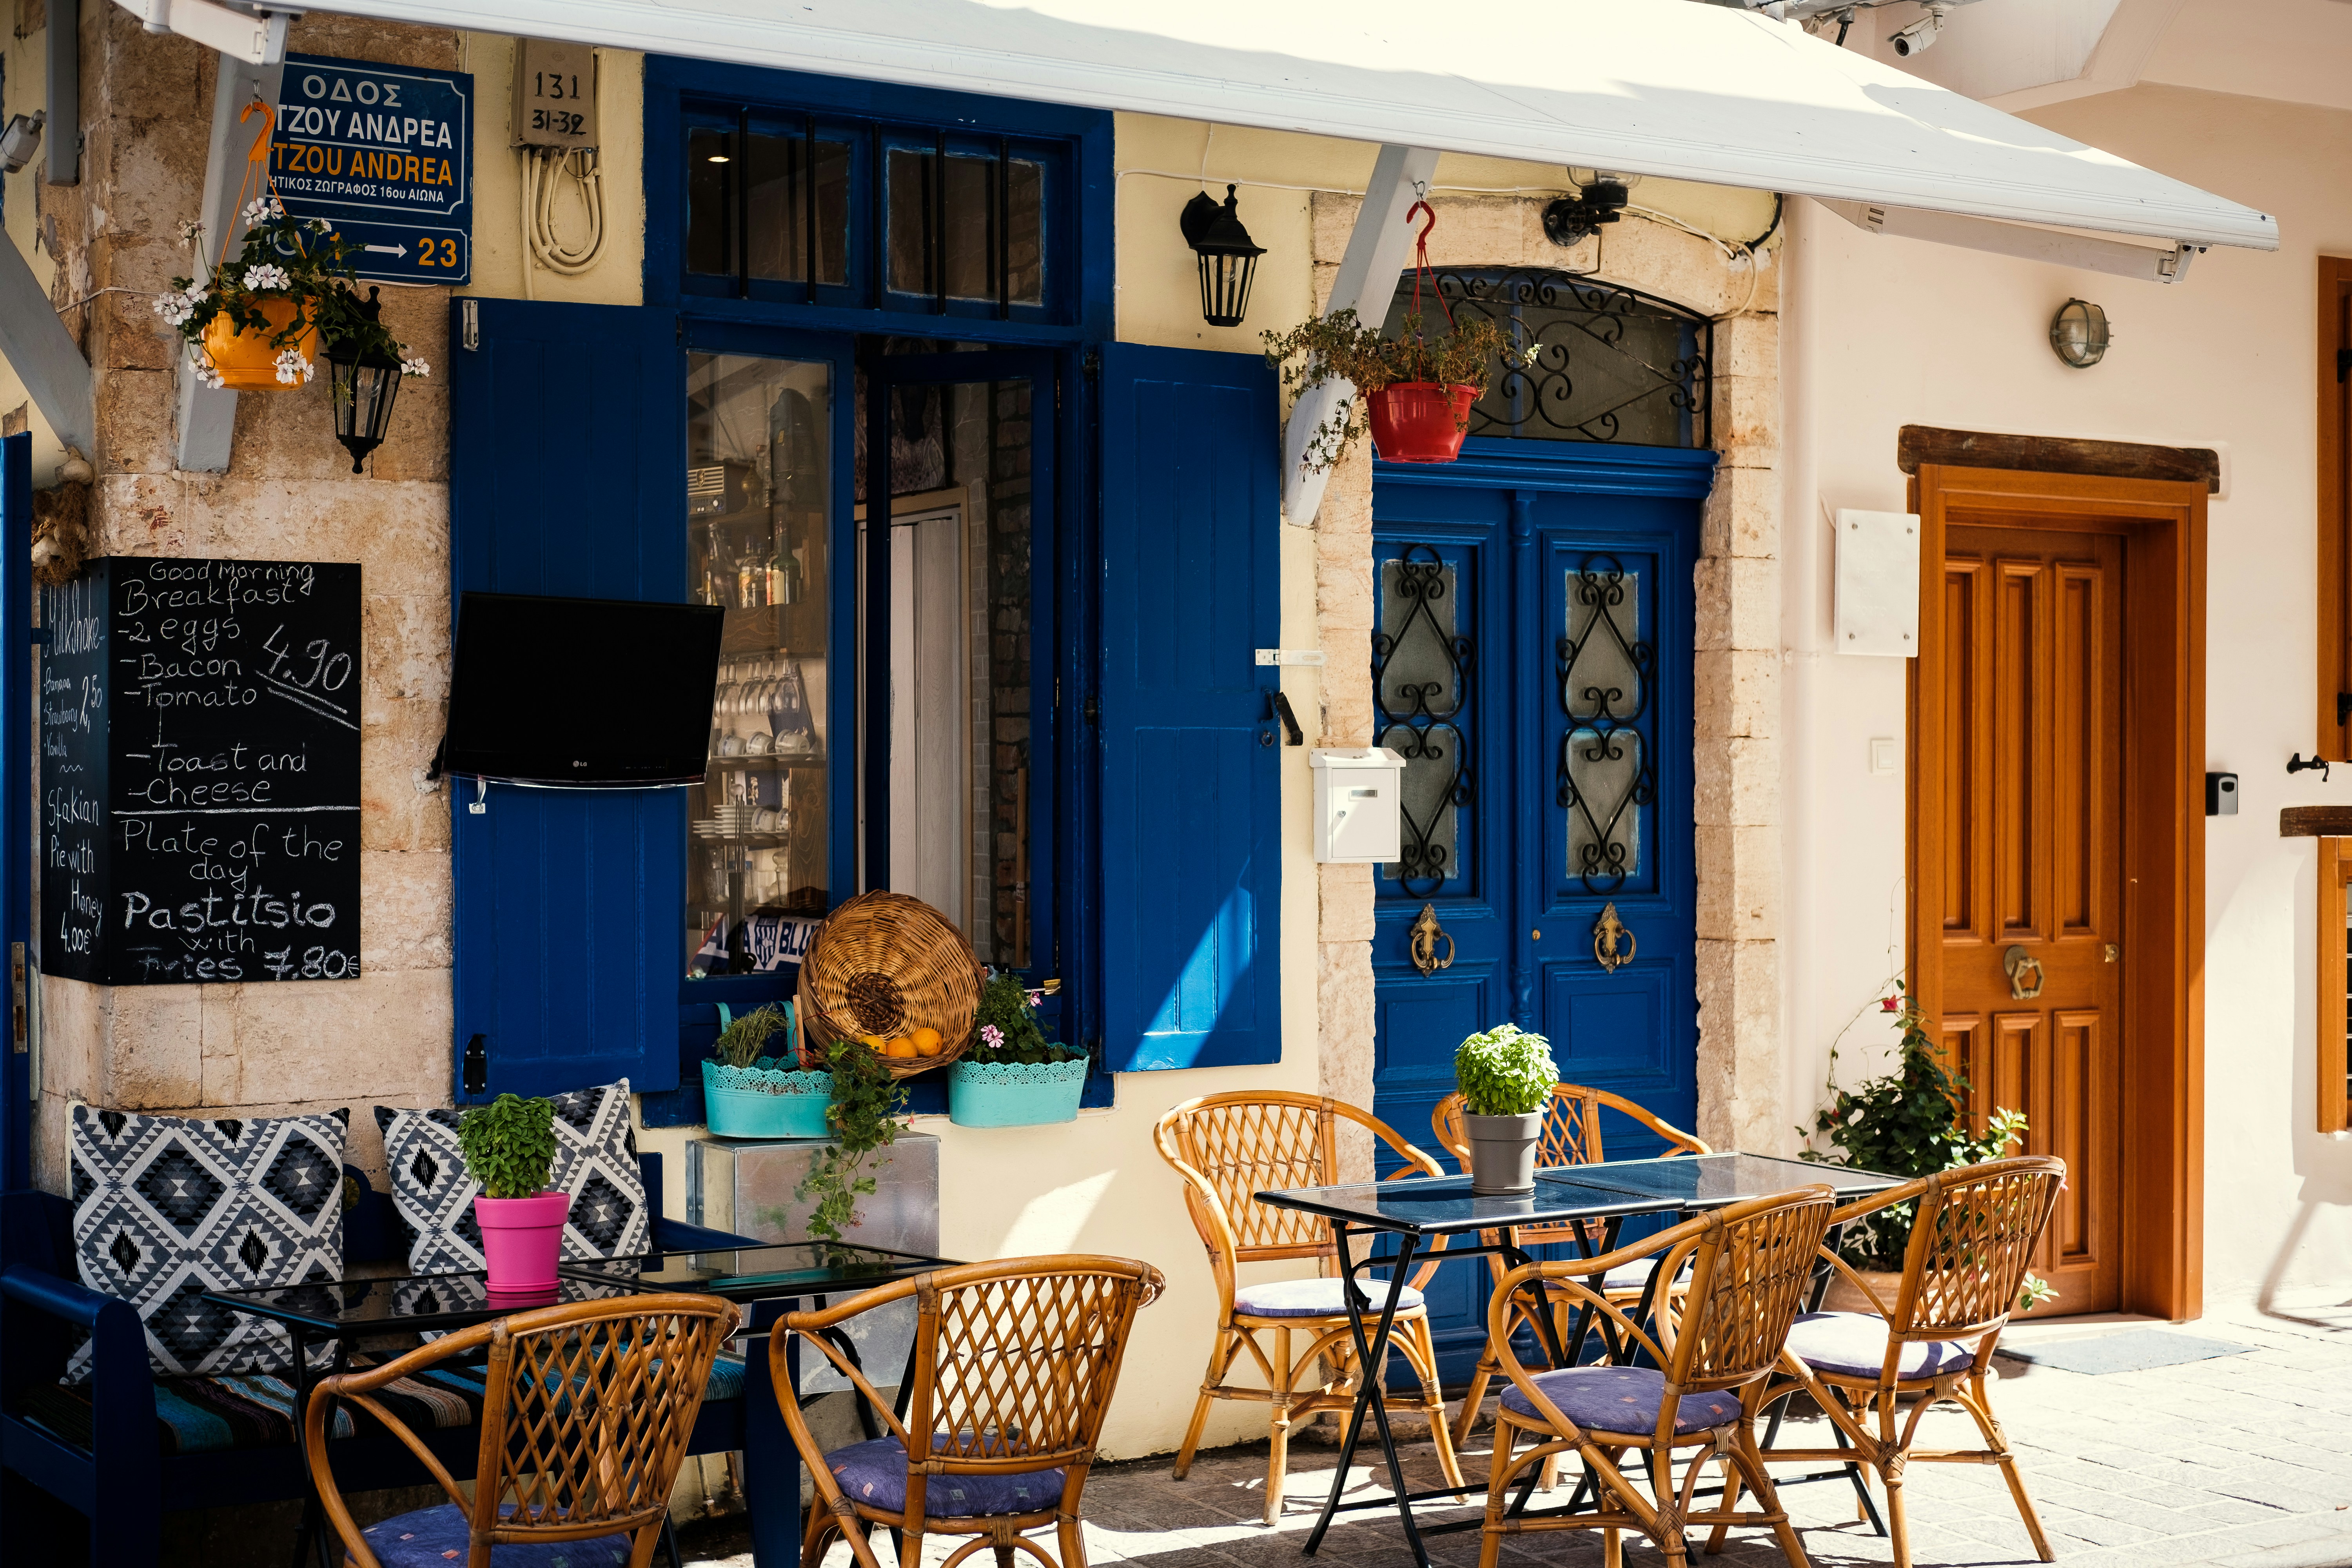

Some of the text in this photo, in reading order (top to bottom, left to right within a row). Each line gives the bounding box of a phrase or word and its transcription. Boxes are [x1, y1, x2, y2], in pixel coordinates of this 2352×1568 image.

[303, 75, 401, 107] ΟΔΟΣ
[534, 71, 580, 99] 131
[348, 112, 452, 149] ΑΝΔΡΕΑ
[532, 109, 587, 136] 31-32
[274, 143, 453, 186] TZOU ANDREA
[315, 180, 377, 196] ΖΩΓΡΑΦΟΣ
[408, 189, 444, 202] ΑΙΩΝΑ
[418, 238, 457, 267] 23
[119, 577, 295, 616] Breakfast
[150, 561, 314, 595] Good Morning
[161, 618, 240, 655] eggs
[262, 622, 352, 691] 4.90
[259, 742, 307, 771] and
[48, 785, 99, 833] Sfakian
[51, 835, 94, 874] Pie with
[119, 819, 343, 867] Plate of the
[190, 857, 247, 893] day
[72, 878, 102, 937] Honey
[121, 885, 335, 933] Pastitsio
[61, 911, 92, 954] 4.00€
[178, 928, 255, 953] with
[264, 945, 359, 981] 7.80€
